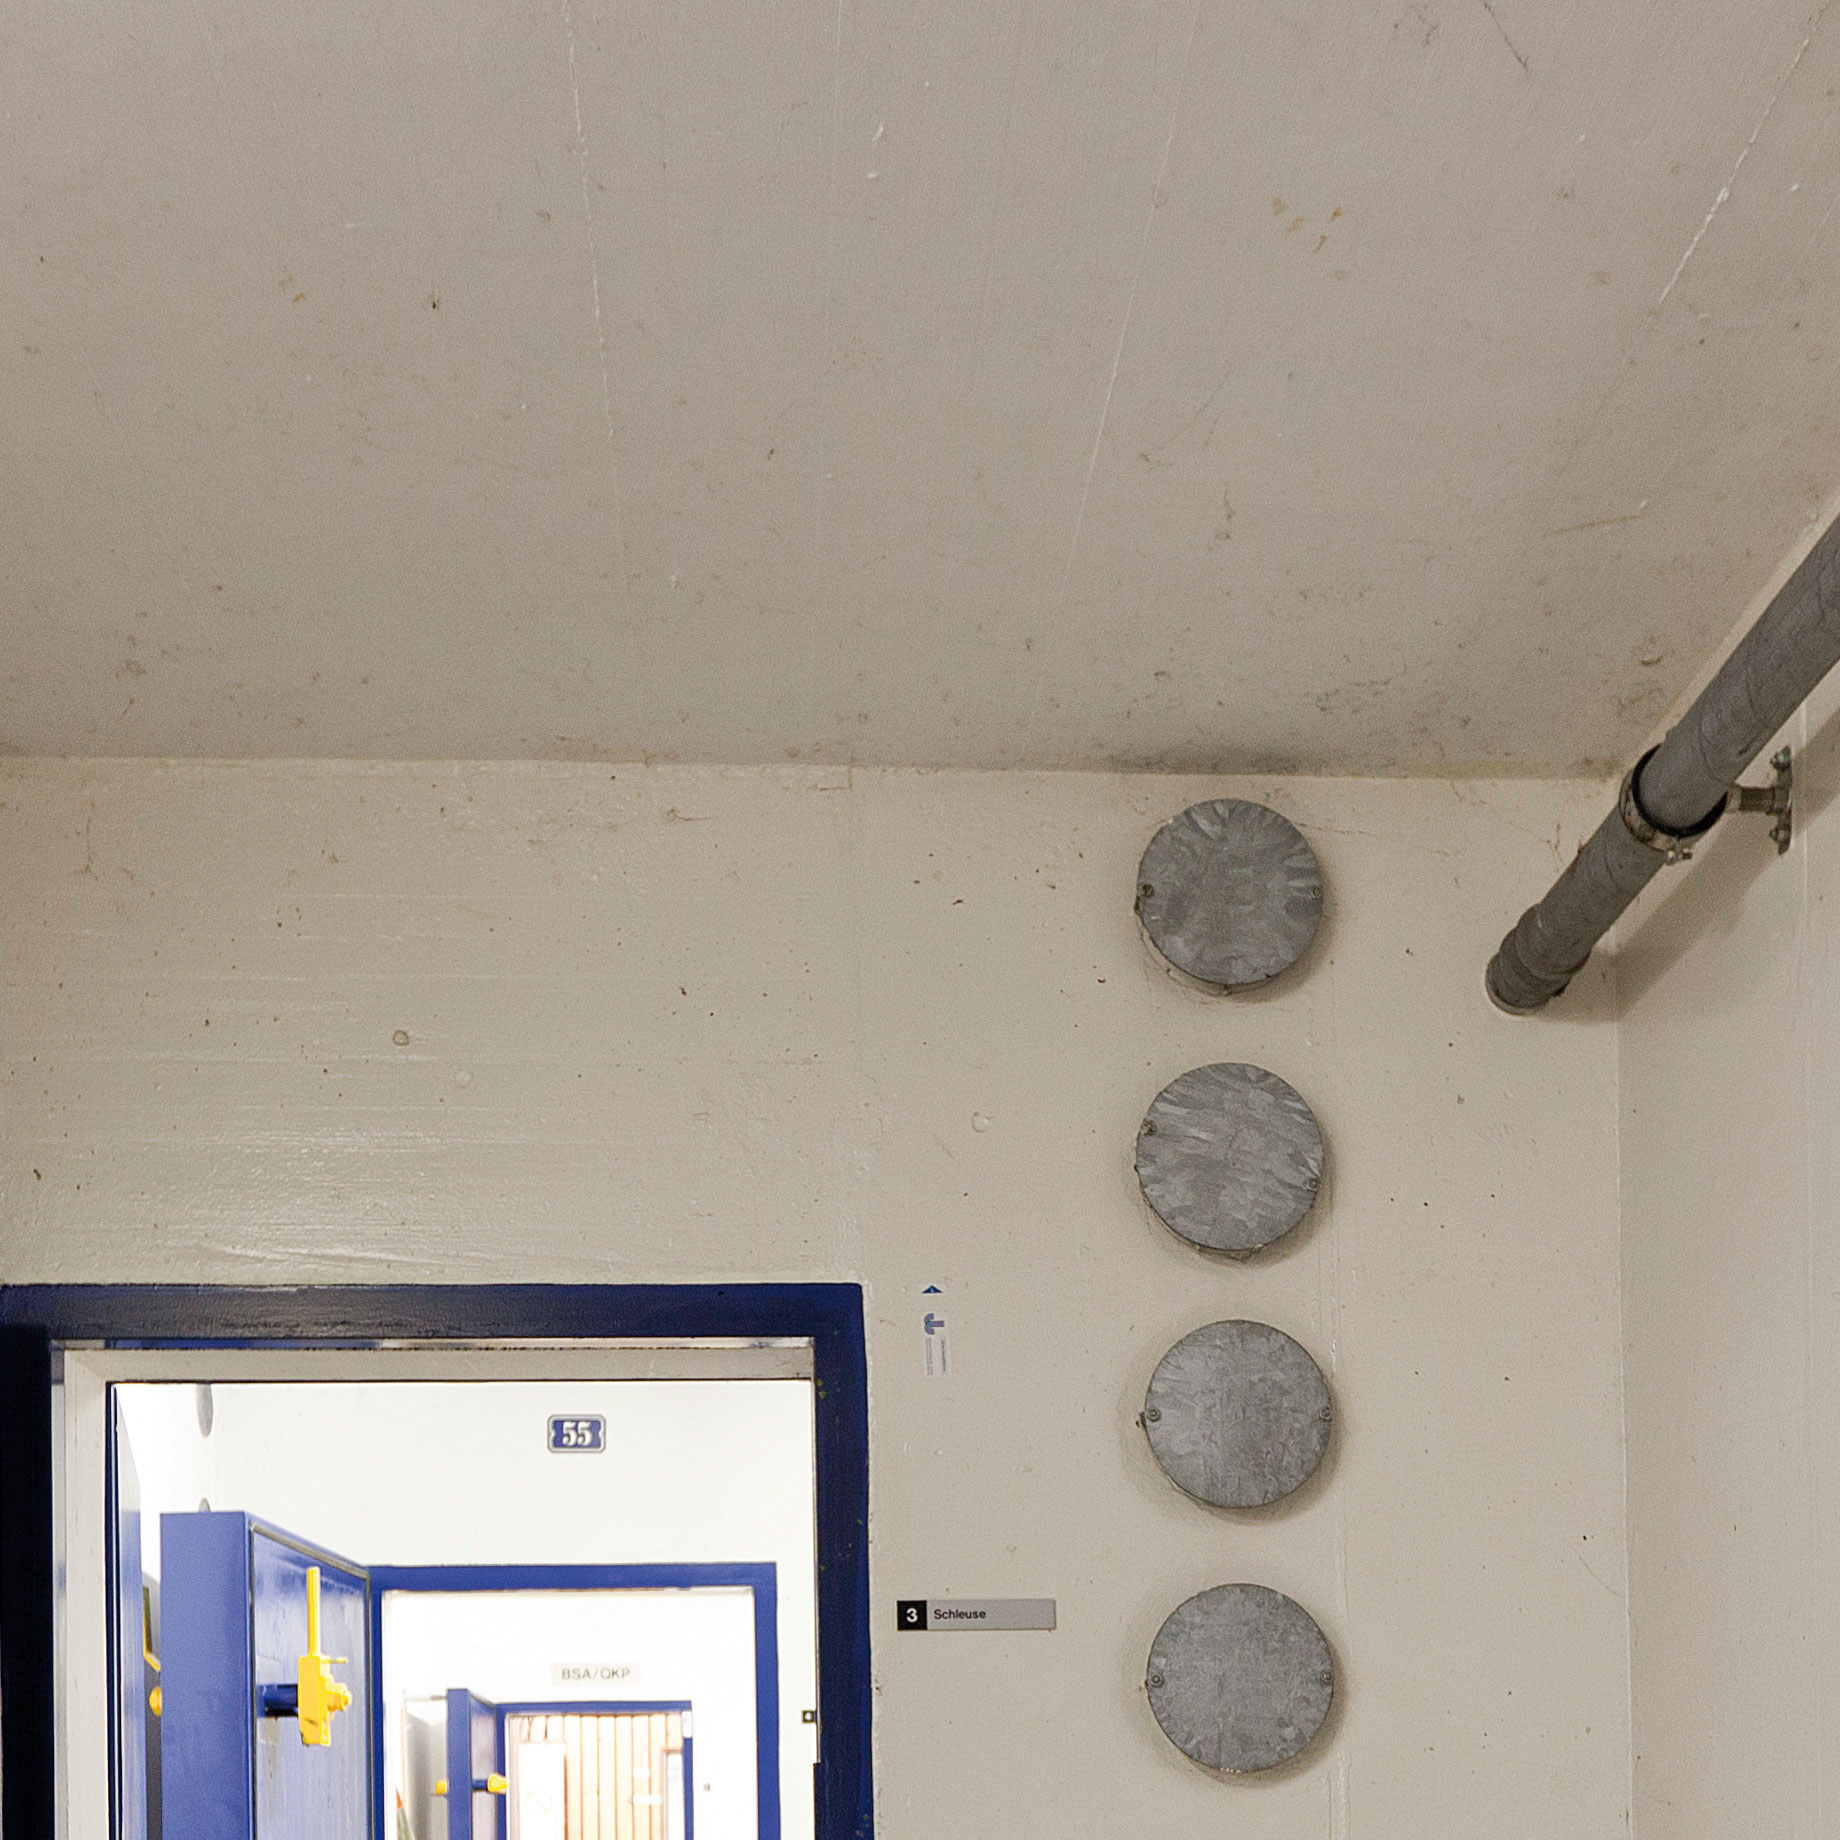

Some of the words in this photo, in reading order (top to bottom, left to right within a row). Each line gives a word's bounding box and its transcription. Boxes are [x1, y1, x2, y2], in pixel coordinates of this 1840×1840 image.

[562, 1421, 593, 1446] 55
[906, 1607, 918, 1623] 3
[933, 1608, 987, 1620] Schleuse
